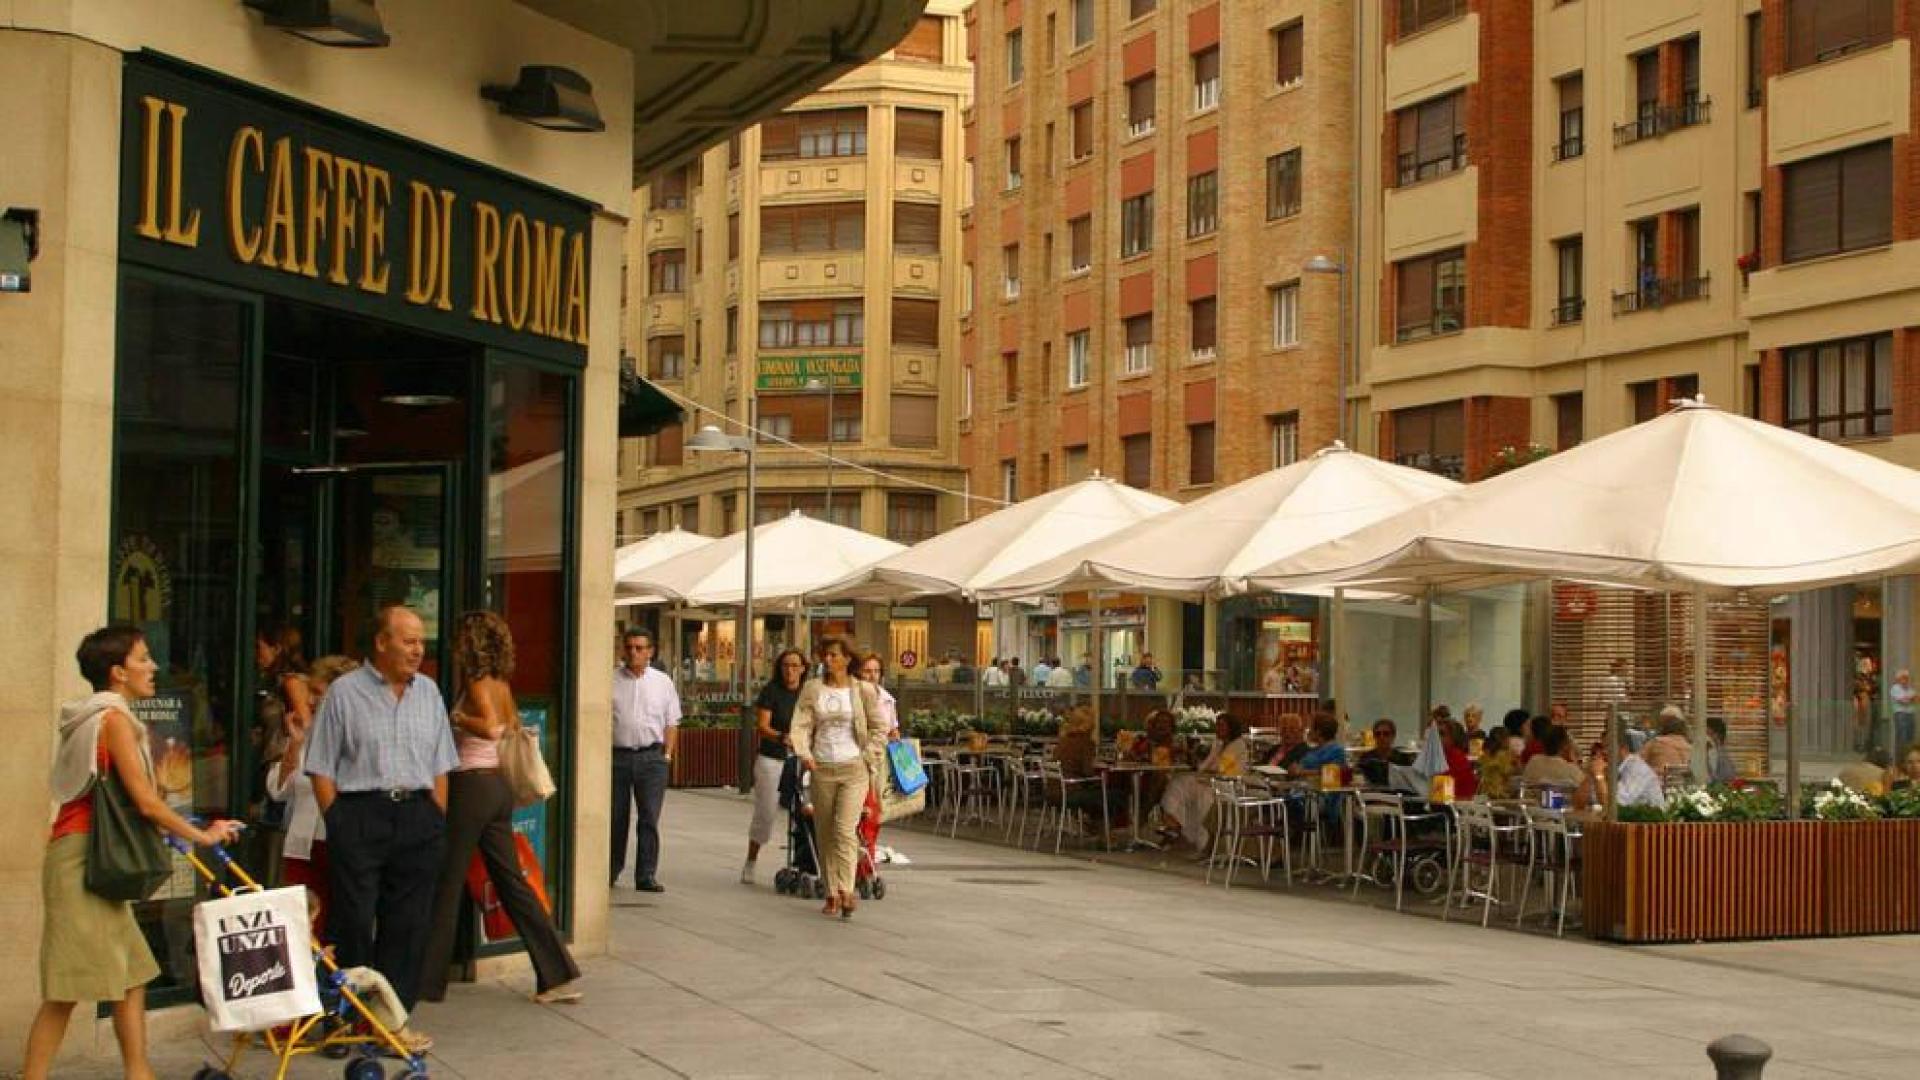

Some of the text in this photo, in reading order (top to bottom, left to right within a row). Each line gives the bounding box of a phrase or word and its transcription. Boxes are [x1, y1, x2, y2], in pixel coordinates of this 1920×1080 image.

[135, 95, 590, 346] IL CAFFE DI ROMA
[220, 928, 286, 955] UNZU
